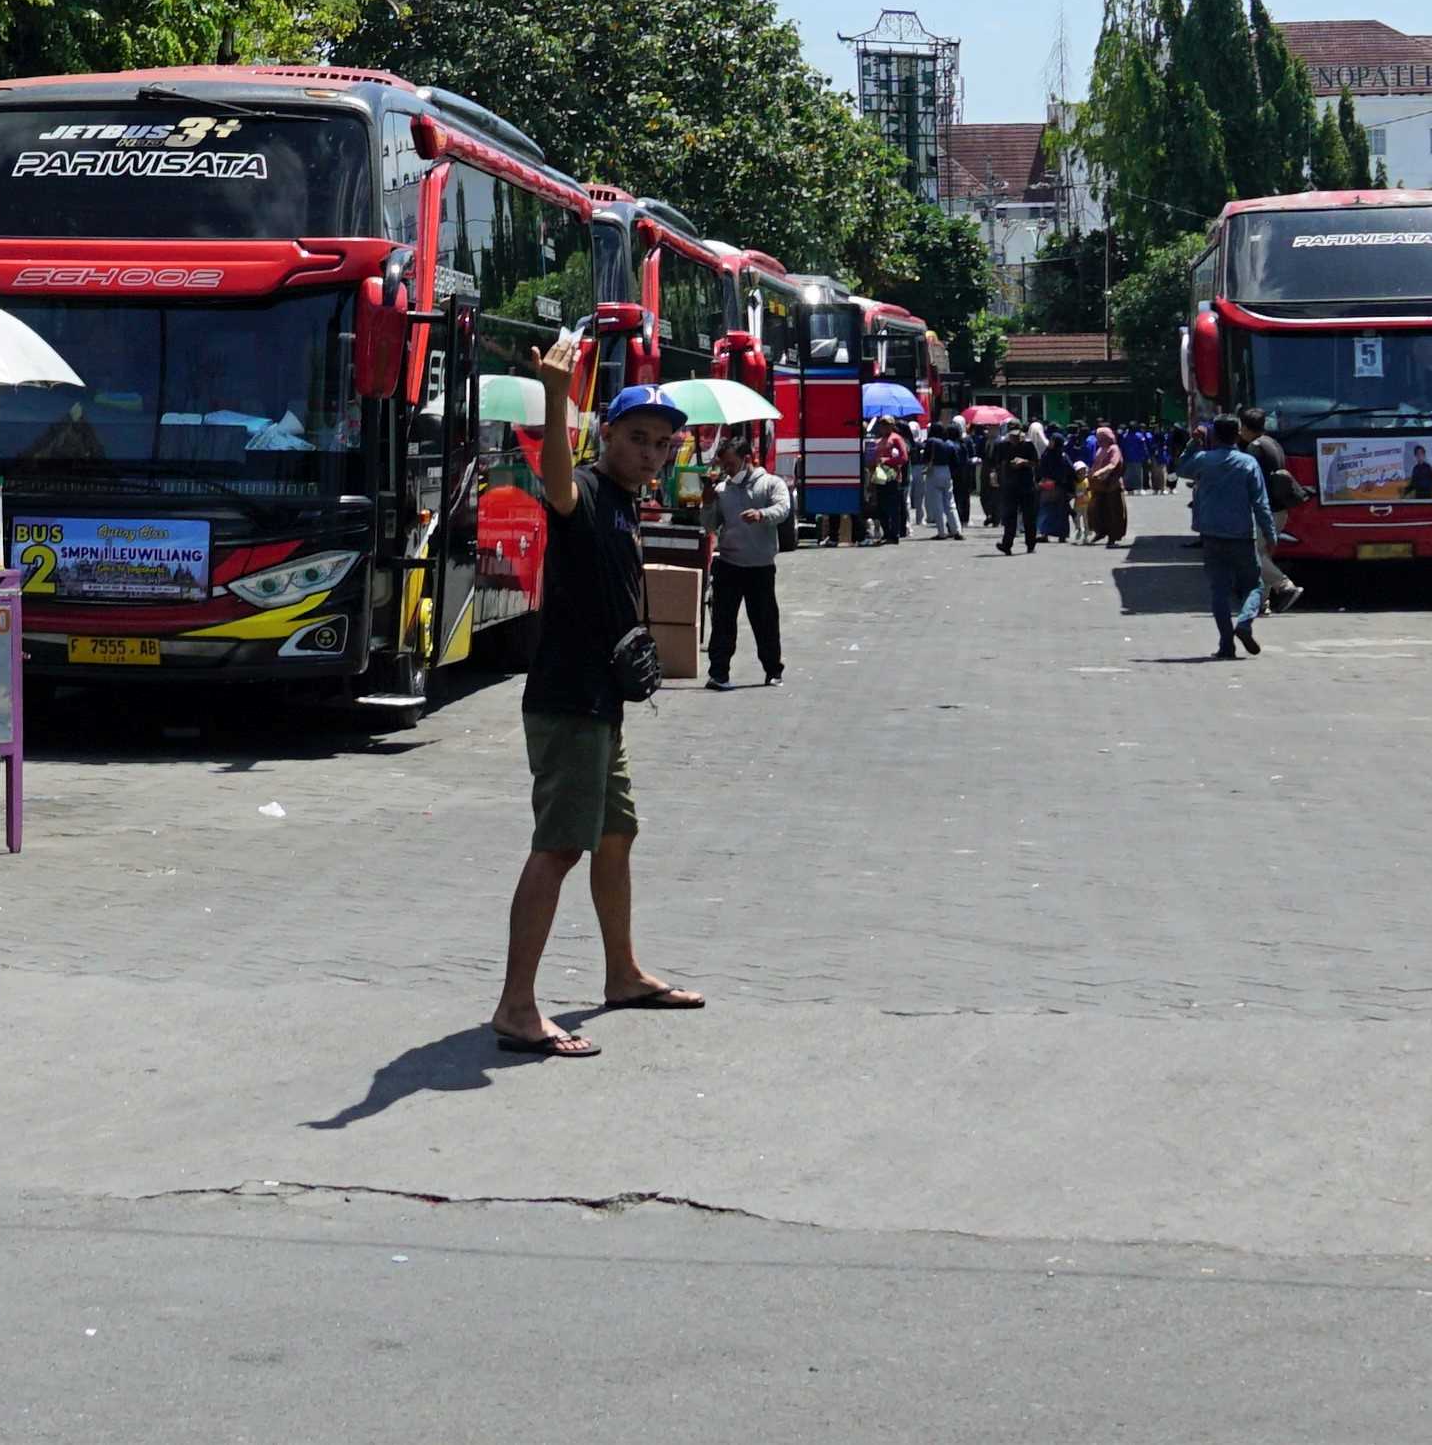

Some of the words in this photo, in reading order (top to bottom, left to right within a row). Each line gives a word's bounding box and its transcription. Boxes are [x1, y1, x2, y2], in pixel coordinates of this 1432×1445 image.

[11, 150, 268, 180] PARIWISATA
[1361, 343, 1377, 367] 5
[15, 523, 64, 544] BUS
[60, 546, 99, 560] SMPN
[112, 547, 204, 562] LEUWILIANG
[20, 544, 59, 595] 2
[89, 638, 127, 655] 7555
